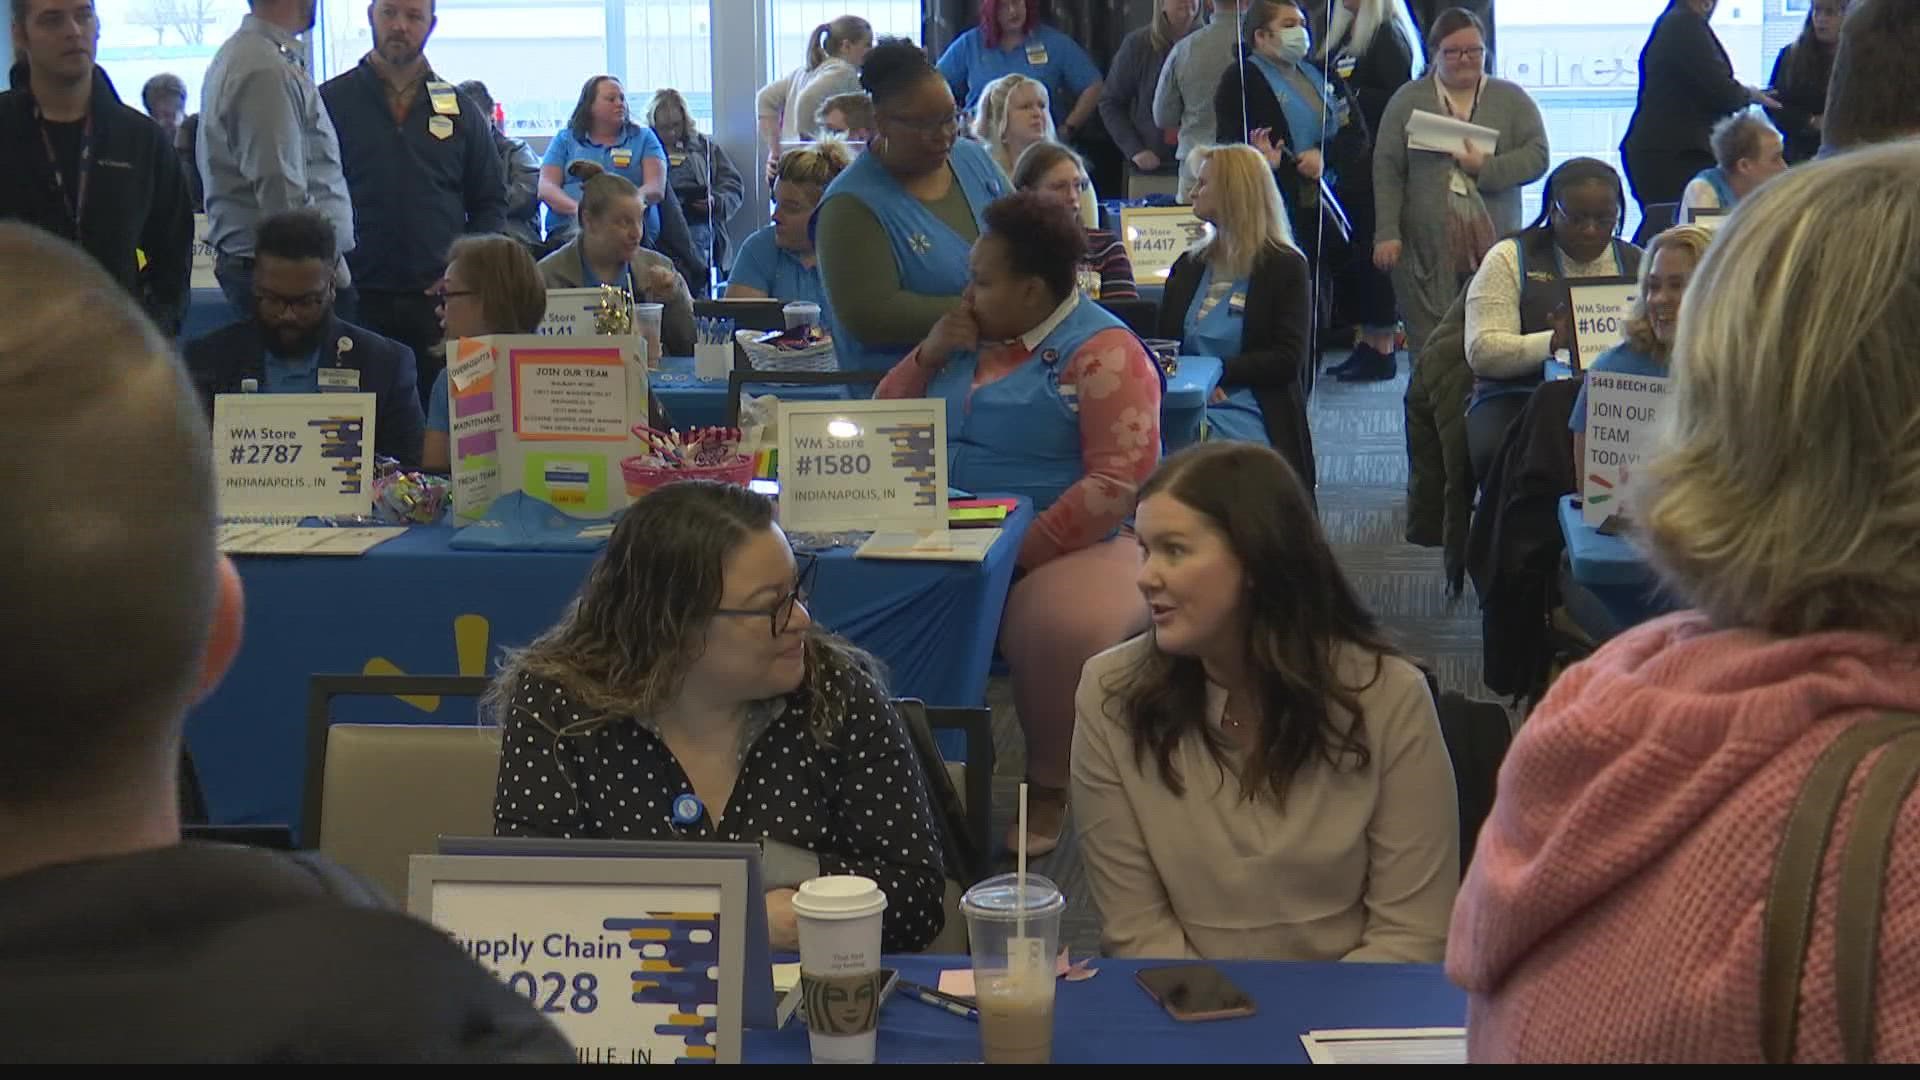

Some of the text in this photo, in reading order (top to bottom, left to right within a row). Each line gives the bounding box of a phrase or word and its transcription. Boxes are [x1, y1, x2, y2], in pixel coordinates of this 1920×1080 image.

[1133, 238, 1176, 251] #4417
[1575, 304, 1595, 313] WM
[548, 312, 576, 322] Store
[536, 367, 609, 378] JOIN OUR TEAM
[1616, 380, 1647, 393] BEECH
[1592, 402, 1657, 423] JOIN OUR
[453, 414, 502, 432] MAINTENANCE
[230, 427, 297, 440] WM Store
[1592, 425, 1631, 444] TEAM
[794, 436, 865, 449] WM Store
[229, 444, 303, 465] #2787
[796, 454, 871, 476] #1580
[313, 476, 326, 488] IN
[794, 488, 896, 502] INDIANAPOLIS, IN
[459, 932, 622, 964] upply Chain
[631, 1047, 652, 1065] IN
